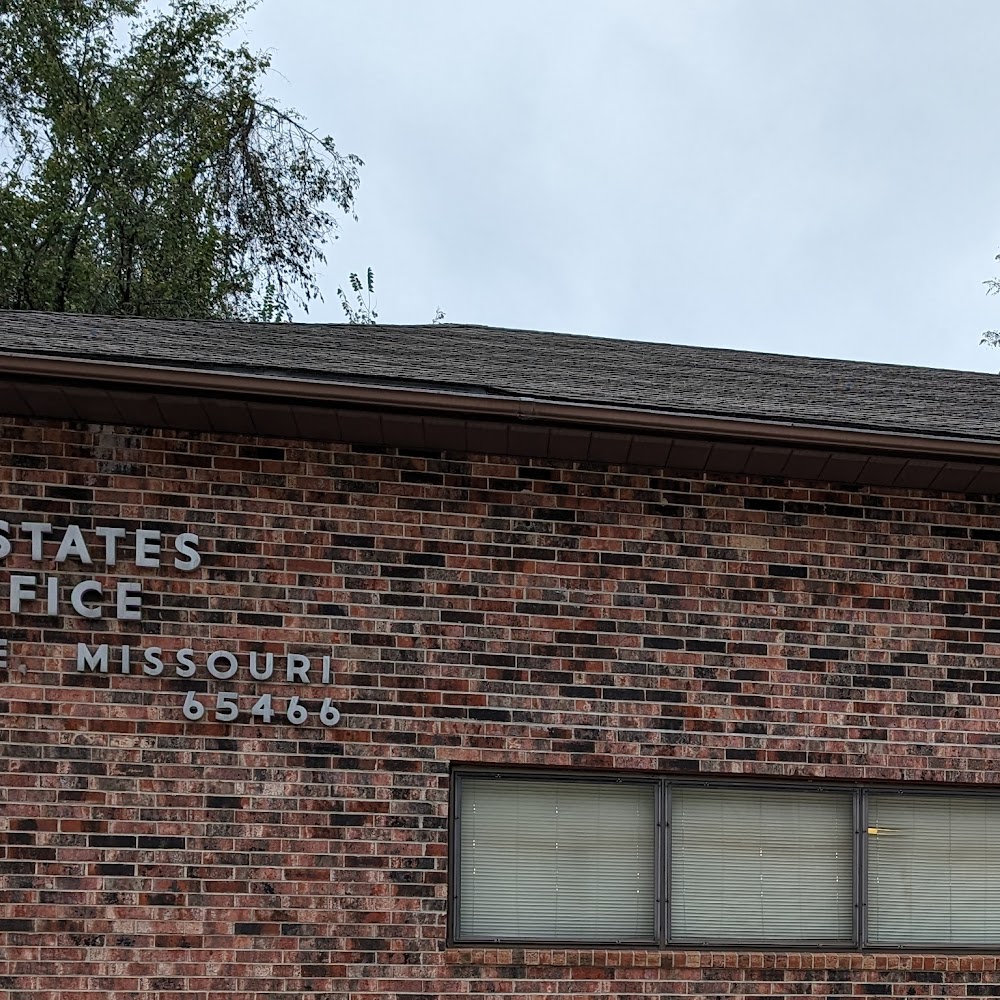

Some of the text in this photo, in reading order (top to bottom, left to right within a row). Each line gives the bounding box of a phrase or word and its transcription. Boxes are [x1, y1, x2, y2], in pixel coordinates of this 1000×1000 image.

[10, 575, 142, 620] FICE
[77, 643, 331, 684] MISSOURI
[183, 691, 341, 727] 65466
